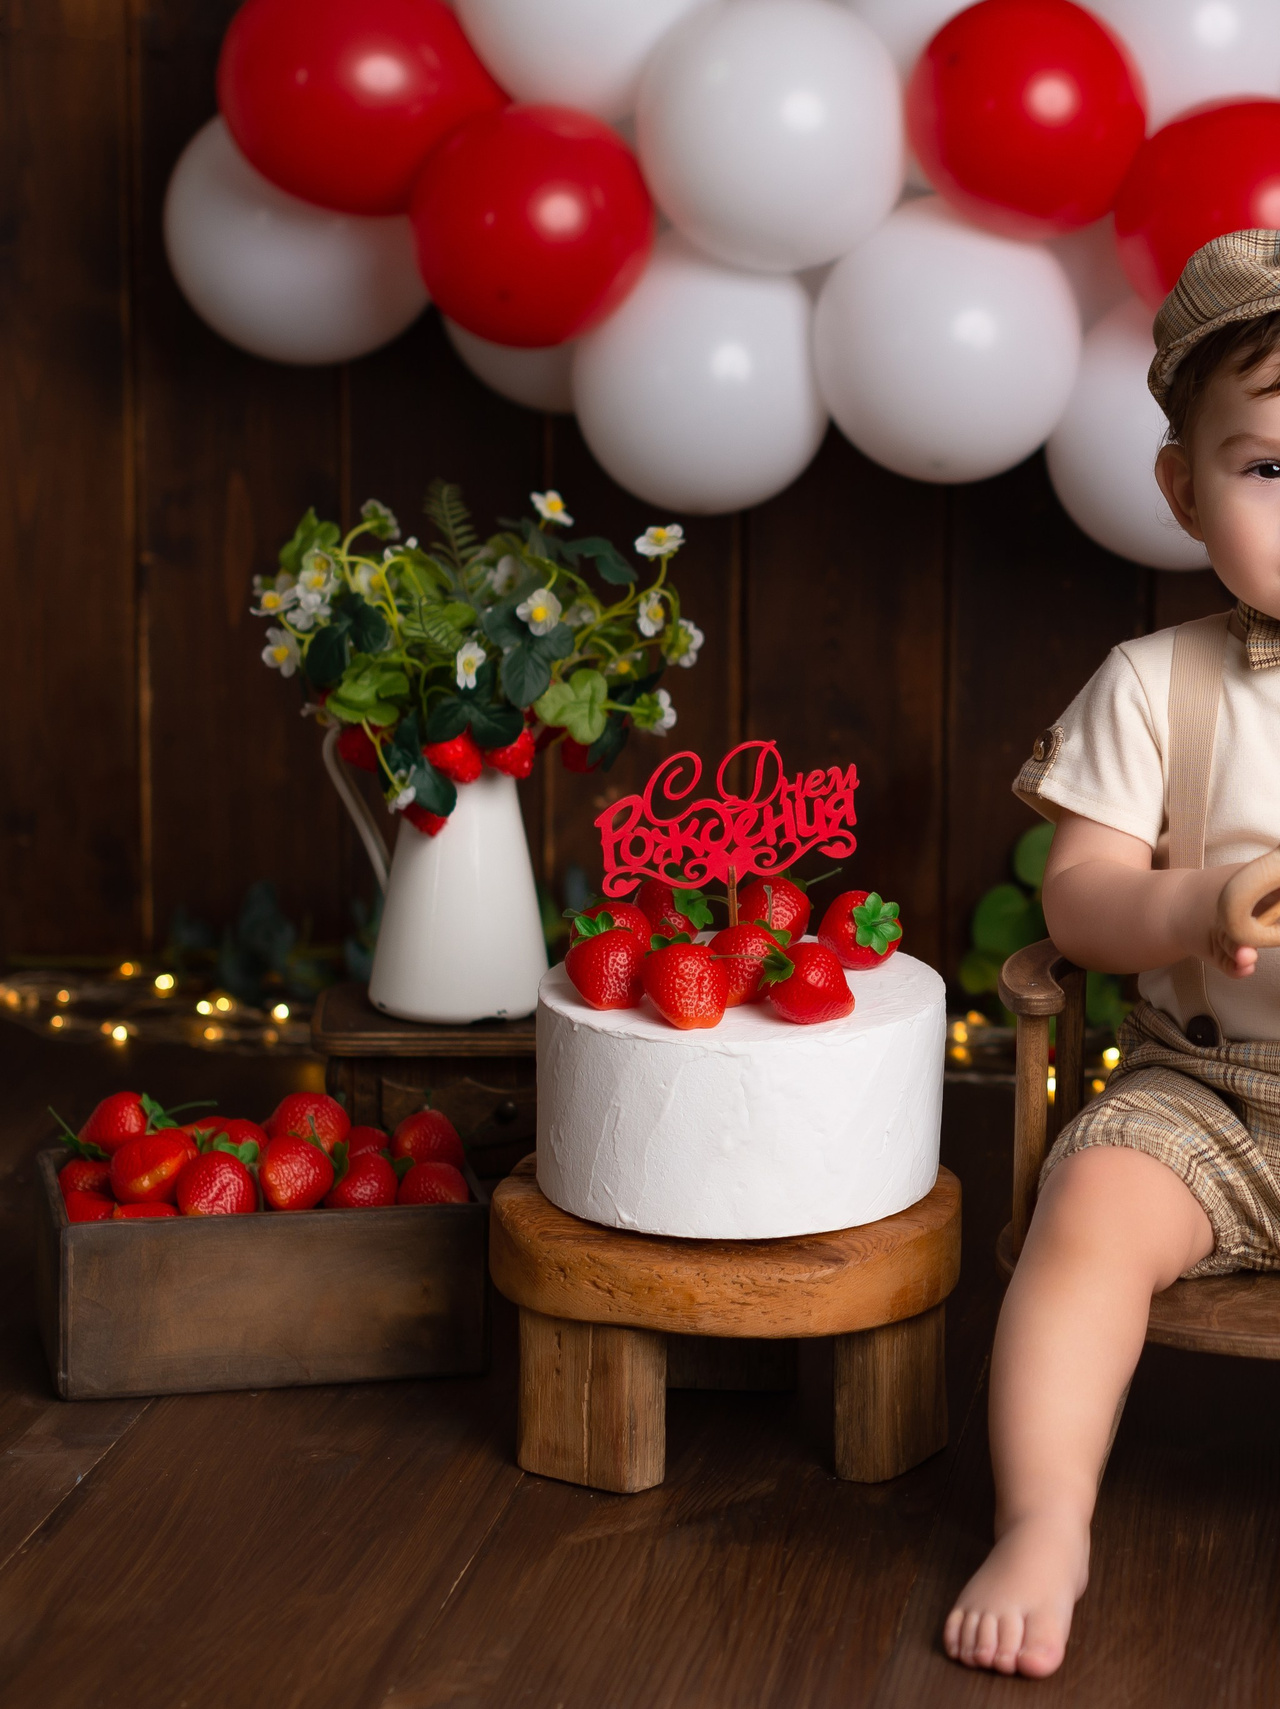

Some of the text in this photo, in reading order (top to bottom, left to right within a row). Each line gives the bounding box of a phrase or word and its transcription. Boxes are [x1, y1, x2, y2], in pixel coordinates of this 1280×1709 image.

[644, 740, 860, 827] С Днем
[594, 790, 858, 873] Рождения
